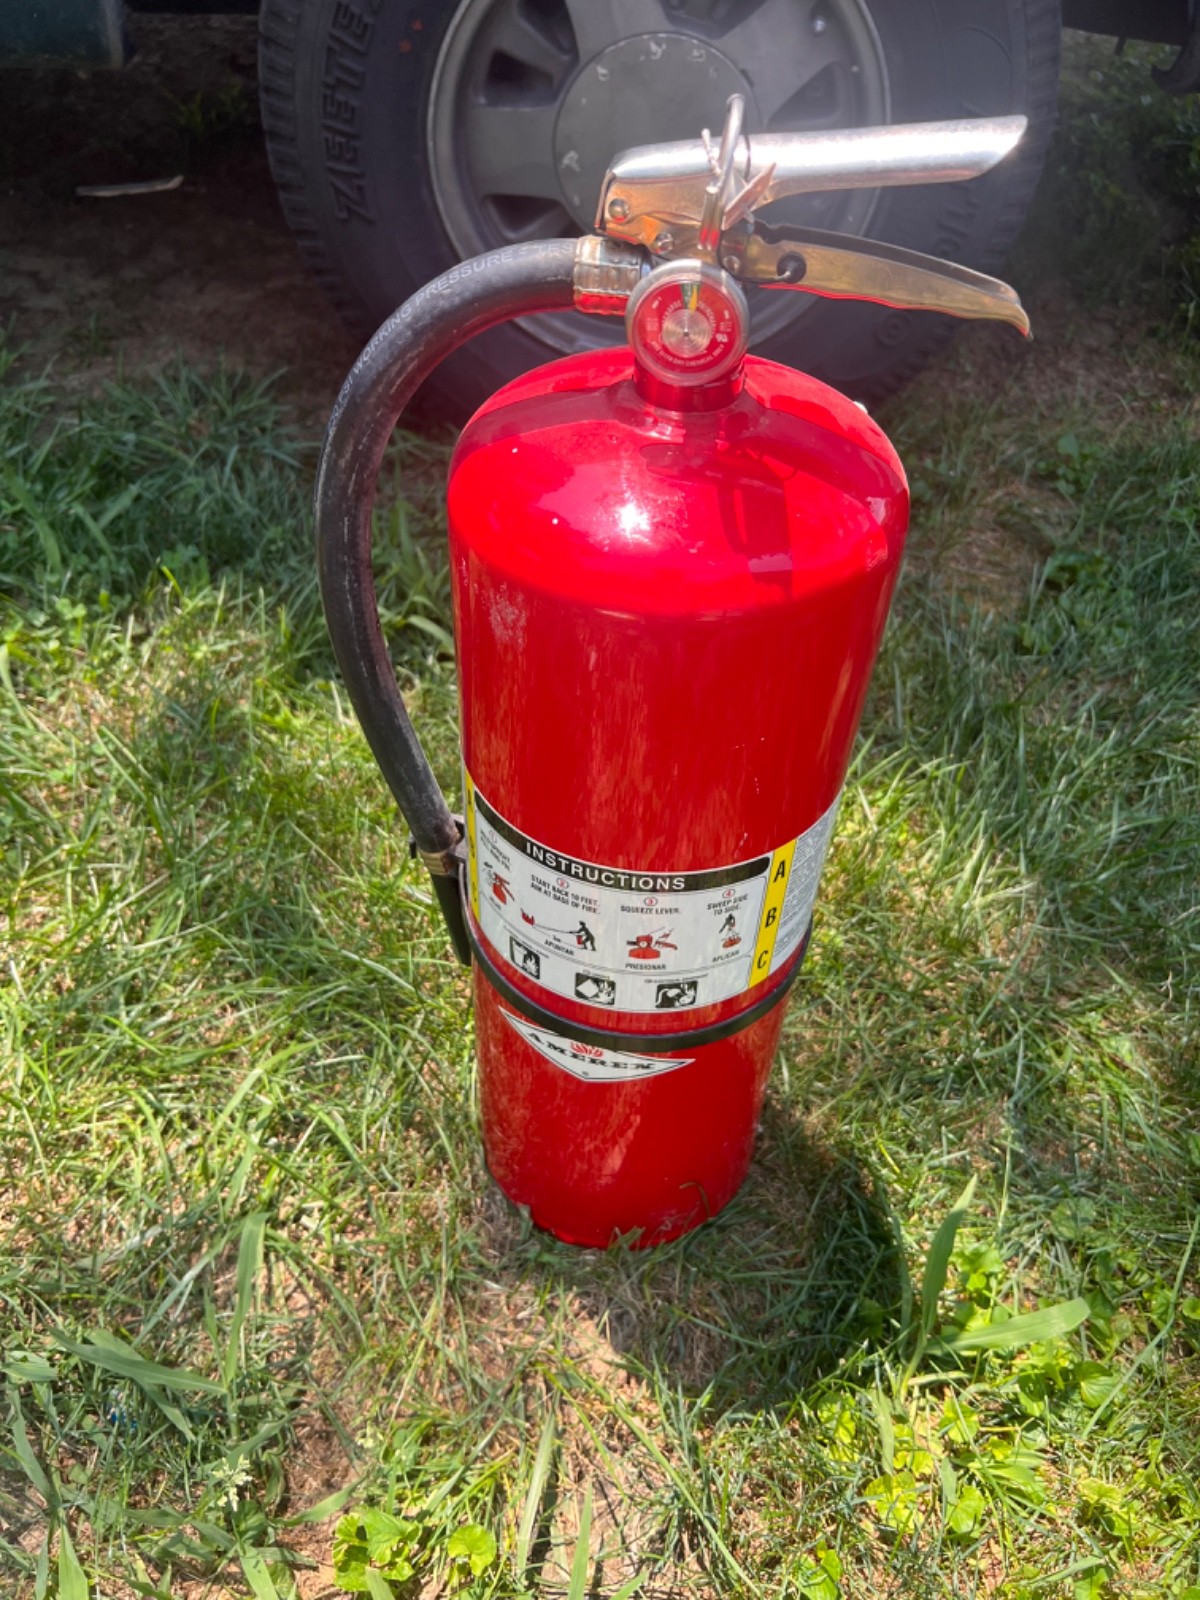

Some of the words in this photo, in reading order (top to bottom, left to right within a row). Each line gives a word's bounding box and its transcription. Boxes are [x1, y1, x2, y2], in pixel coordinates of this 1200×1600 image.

[321, 0, 382, 225] ZEETE
[353, 304, 412, 374] WORKING
[415, 249, 514, 306] PRESSURE
[526, 841, 685, 890] INSTRUCTIONS
[773, 859, 786, 883] A
[620, 905, 653, 914] SQUEEZE
[707, 899, 732, 910] SWEEP
[765, 907, 777, 928] B
[625, 963, 666, 971] PRESIONAR
[757, 950, 768, 970] C
[527, 1032, 656, 1070] AMEREX
